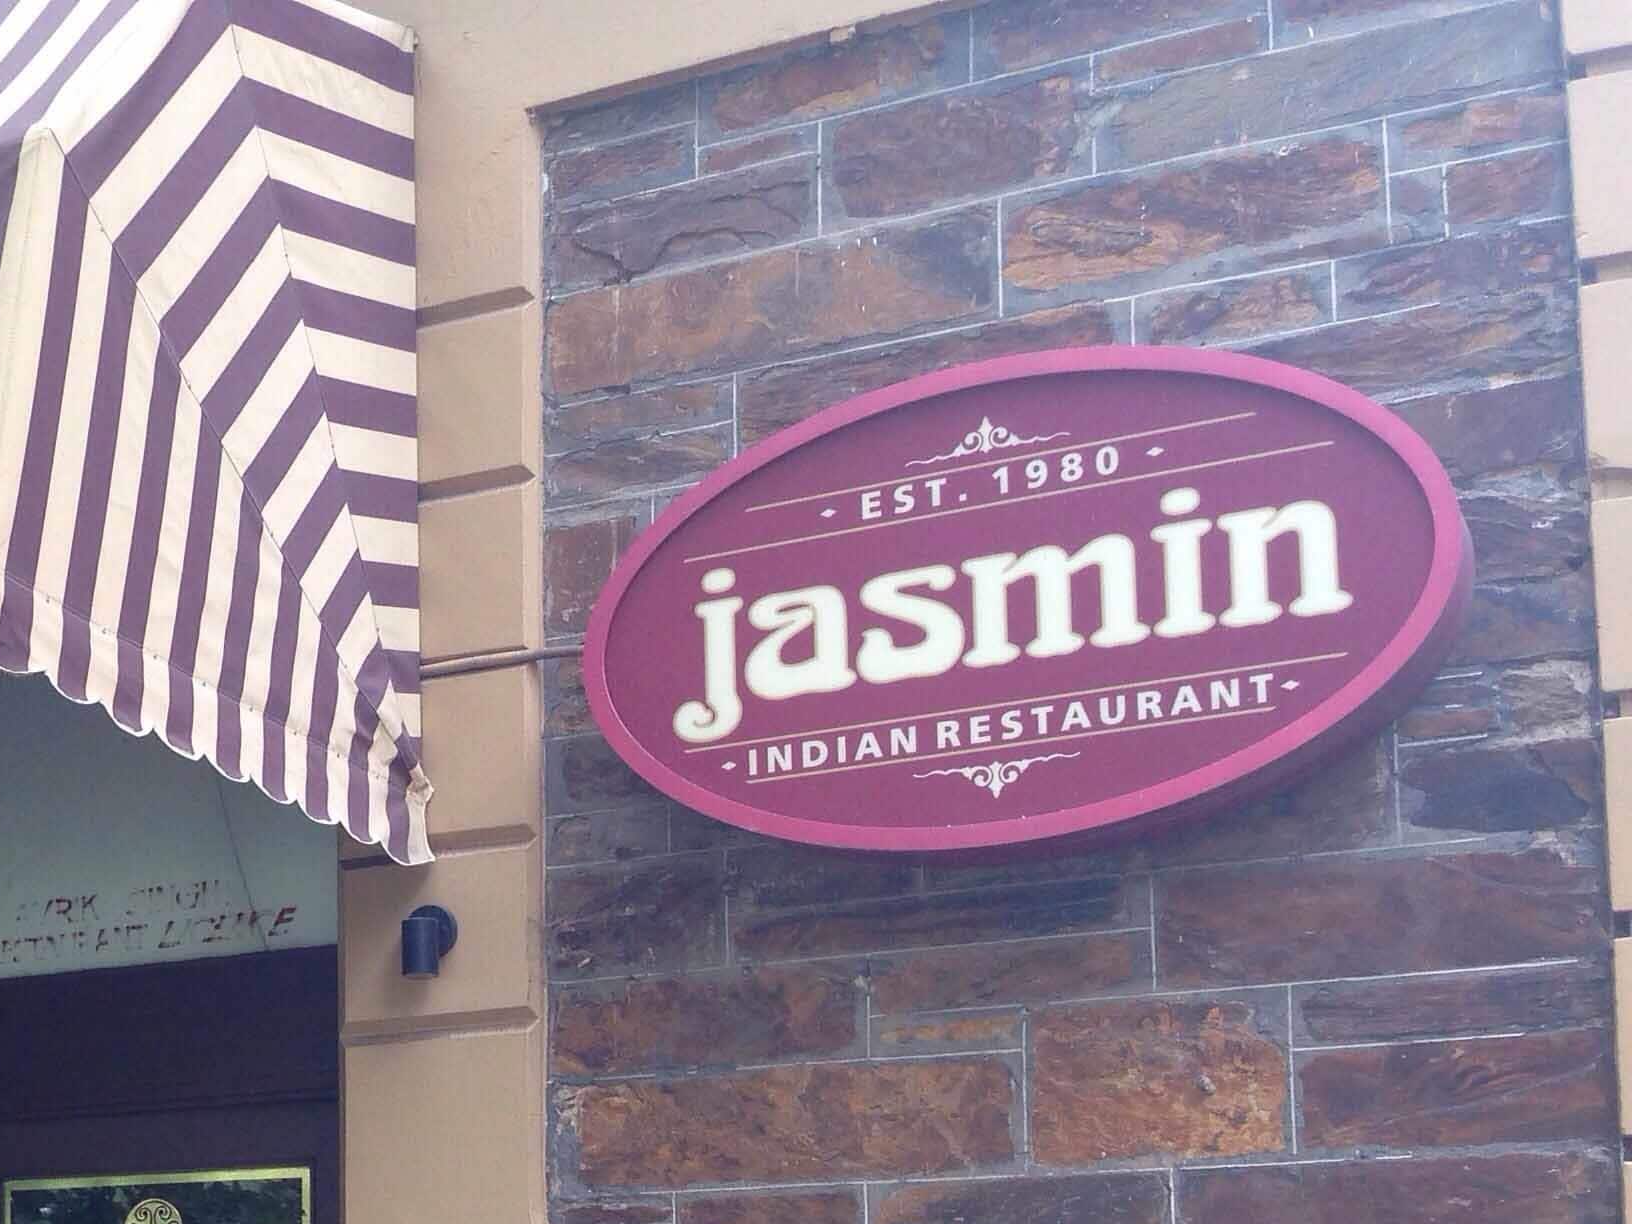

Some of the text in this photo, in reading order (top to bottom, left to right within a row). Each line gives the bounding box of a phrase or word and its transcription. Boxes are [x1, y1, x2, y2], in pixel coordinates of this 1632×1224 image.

[861, 444, 1121, 521] EST. 1980
[671, 485, 1357, 745] jasmin
[747, 672, 1276, 777] INDIAN RESTAURANT
